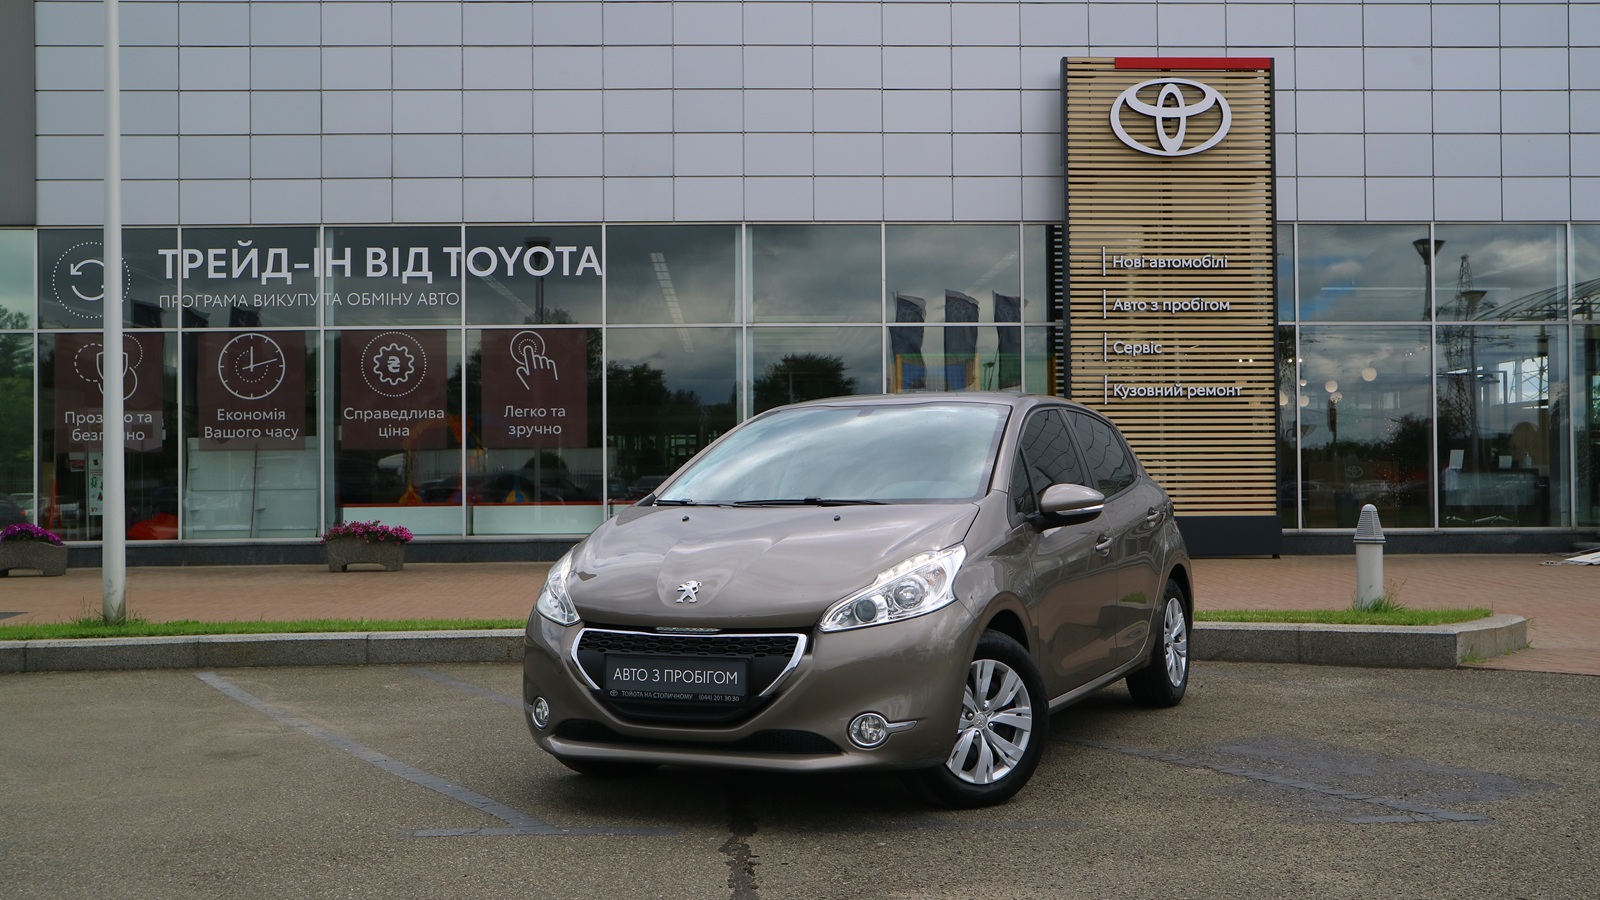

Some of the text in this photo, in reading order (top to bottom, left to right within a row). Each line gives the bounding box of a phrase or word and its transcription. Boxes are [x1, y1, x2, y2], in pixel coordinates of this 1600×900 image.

[158, 240, 603, 285] ТРЕЙД-ІН ВІД TOYOTA
[1113, 255, 1228, 268] Нові автомобілі
[159, 292, 460, 308] ПРОГРАМА ВИКУПУ ТА ОБМІНУ АВТО
[1113, 297, 1230, 314] Авто з пробігом
[1113, 341, 1162, 356] Сервіс
[1113, 383, 1242, 399] Кузовний ремонт
[65, 411, 152, 426] Прозо та
[217, 408, 286, 421] Економія
[343, 406, 445, 420] Справедлива
[504, 405, 566, 418] Легко та
[204, 427, 299, 441] Вашого часу
[378, 424, 410, 438] ціна
[508, 423, 562, 438] зручно
[613, 668, 648, 682] АВТО
[664, 670, 738, 684] ПРОБІГОМ
